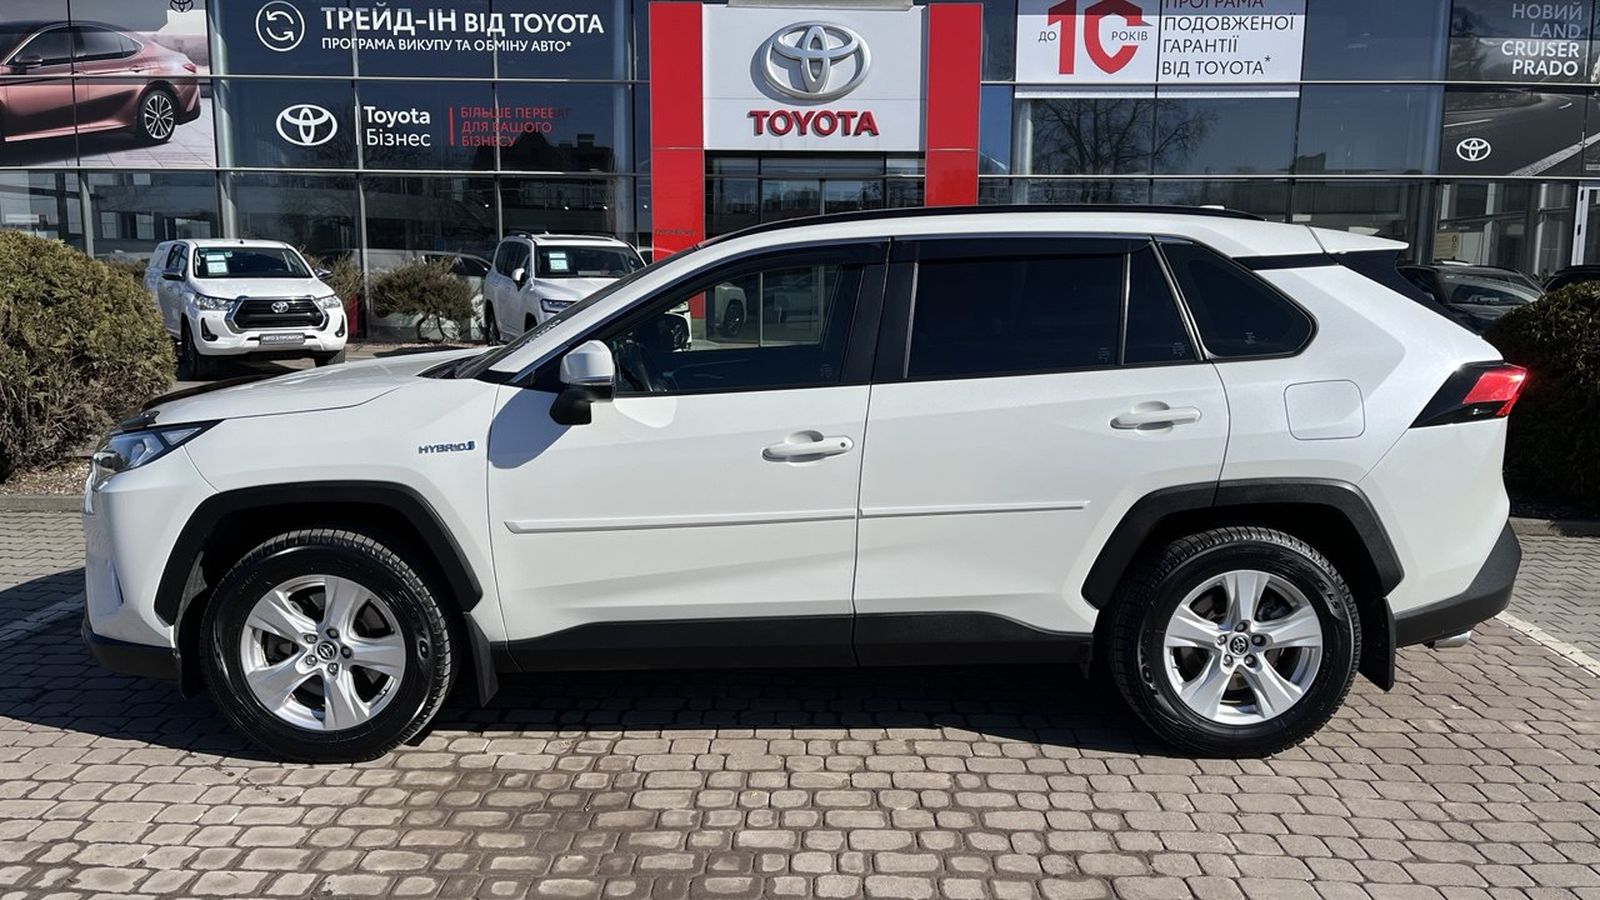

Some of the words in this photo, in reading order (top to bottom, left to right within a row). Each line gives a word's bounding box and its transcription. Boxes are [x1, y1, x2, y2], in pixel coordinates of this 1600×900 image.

[321, 2, 456, 36] ТРЕЙД-ІН
[464, 13, 506, 37] ВІД
[510, 13, 605, 33] TOYOTA
[1512, 2, 1583, 21] НОВИЙ
[1164, 12, 1297, 33] ПОДОВЖЕНОЇ
[1530, 23, 1582, 39] LAND
[322, 37, 396, 50] ПРОГРАМА
[398, 39, 453, 51] ВИКУПУ
[455, 40, 472, 51] ТА
[474, 40, 528, 52] ОБМІНУ
[1038, 31, 1057, 42] ДО
[1111, 31, 1149, 41] РОКІВ
[1163, 35, 1239, 53] ГАРАНТІЇ
[1501, 40, 1580, 58] CRUISER
[1161, 60, 1191, 78] ВІД
[1512, 59, 1579, 76] PRADO
[363, 105, 431, 128] Toyota
[748, 110, 880, 137] TOYOTA
[462, 121, 489, 134] ДЛЯ
[366, 128, 431, 147] Бізнес
[418, 443, 466, 454] HYBRID
